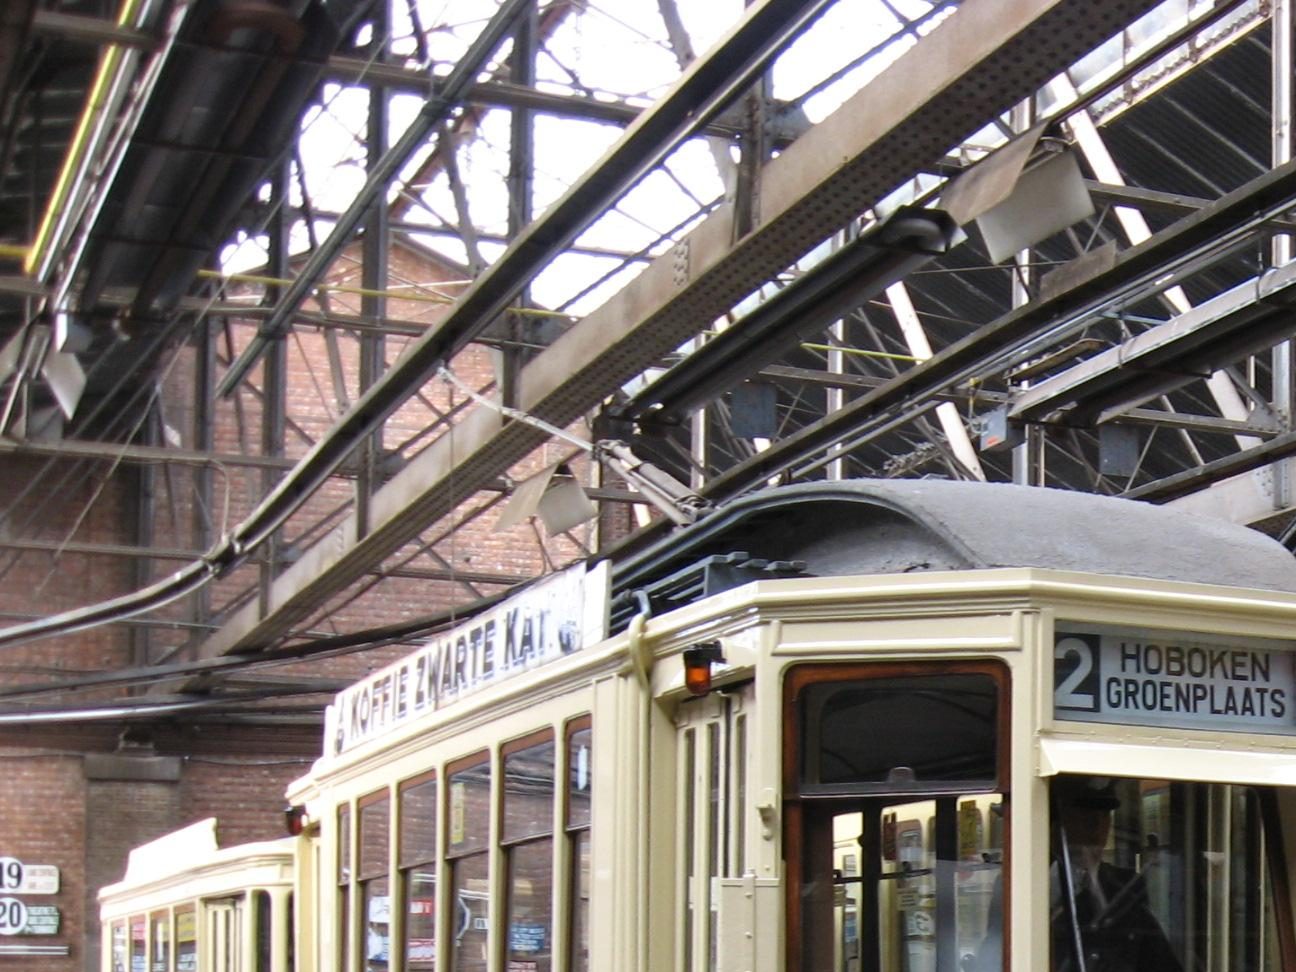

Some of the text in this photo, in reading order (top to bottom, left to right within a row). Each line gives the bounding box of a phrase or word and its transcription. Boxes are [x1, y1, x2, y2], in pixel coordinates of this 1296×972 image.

[350, 664, 409, 741] KOFFIE
[414, 619, 497, 710] ZWARTE
[1054, 637, 1095, 709] 2
[1120, 642, 1270, 682] HOBOKEN
[1106, 676, 1286, 718] GROENPLAATS
